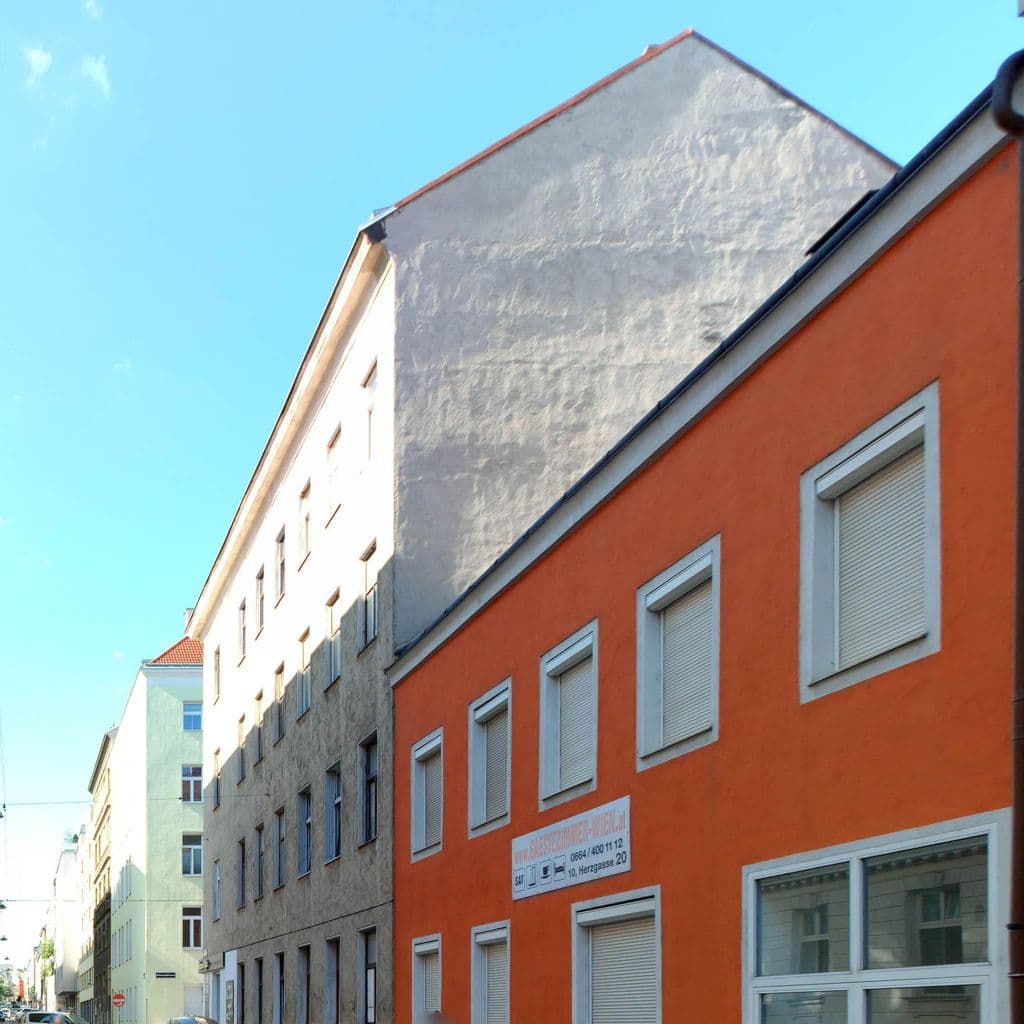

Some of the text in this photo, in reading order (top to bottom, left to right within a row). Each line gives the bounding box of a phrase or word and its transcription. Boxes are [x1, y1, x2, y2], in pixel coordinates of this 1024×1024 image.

[578, 858, 615, 874] Herzgasse
[616, 851, 628, 865] 20
[514, 874, 525, 886] SAT
